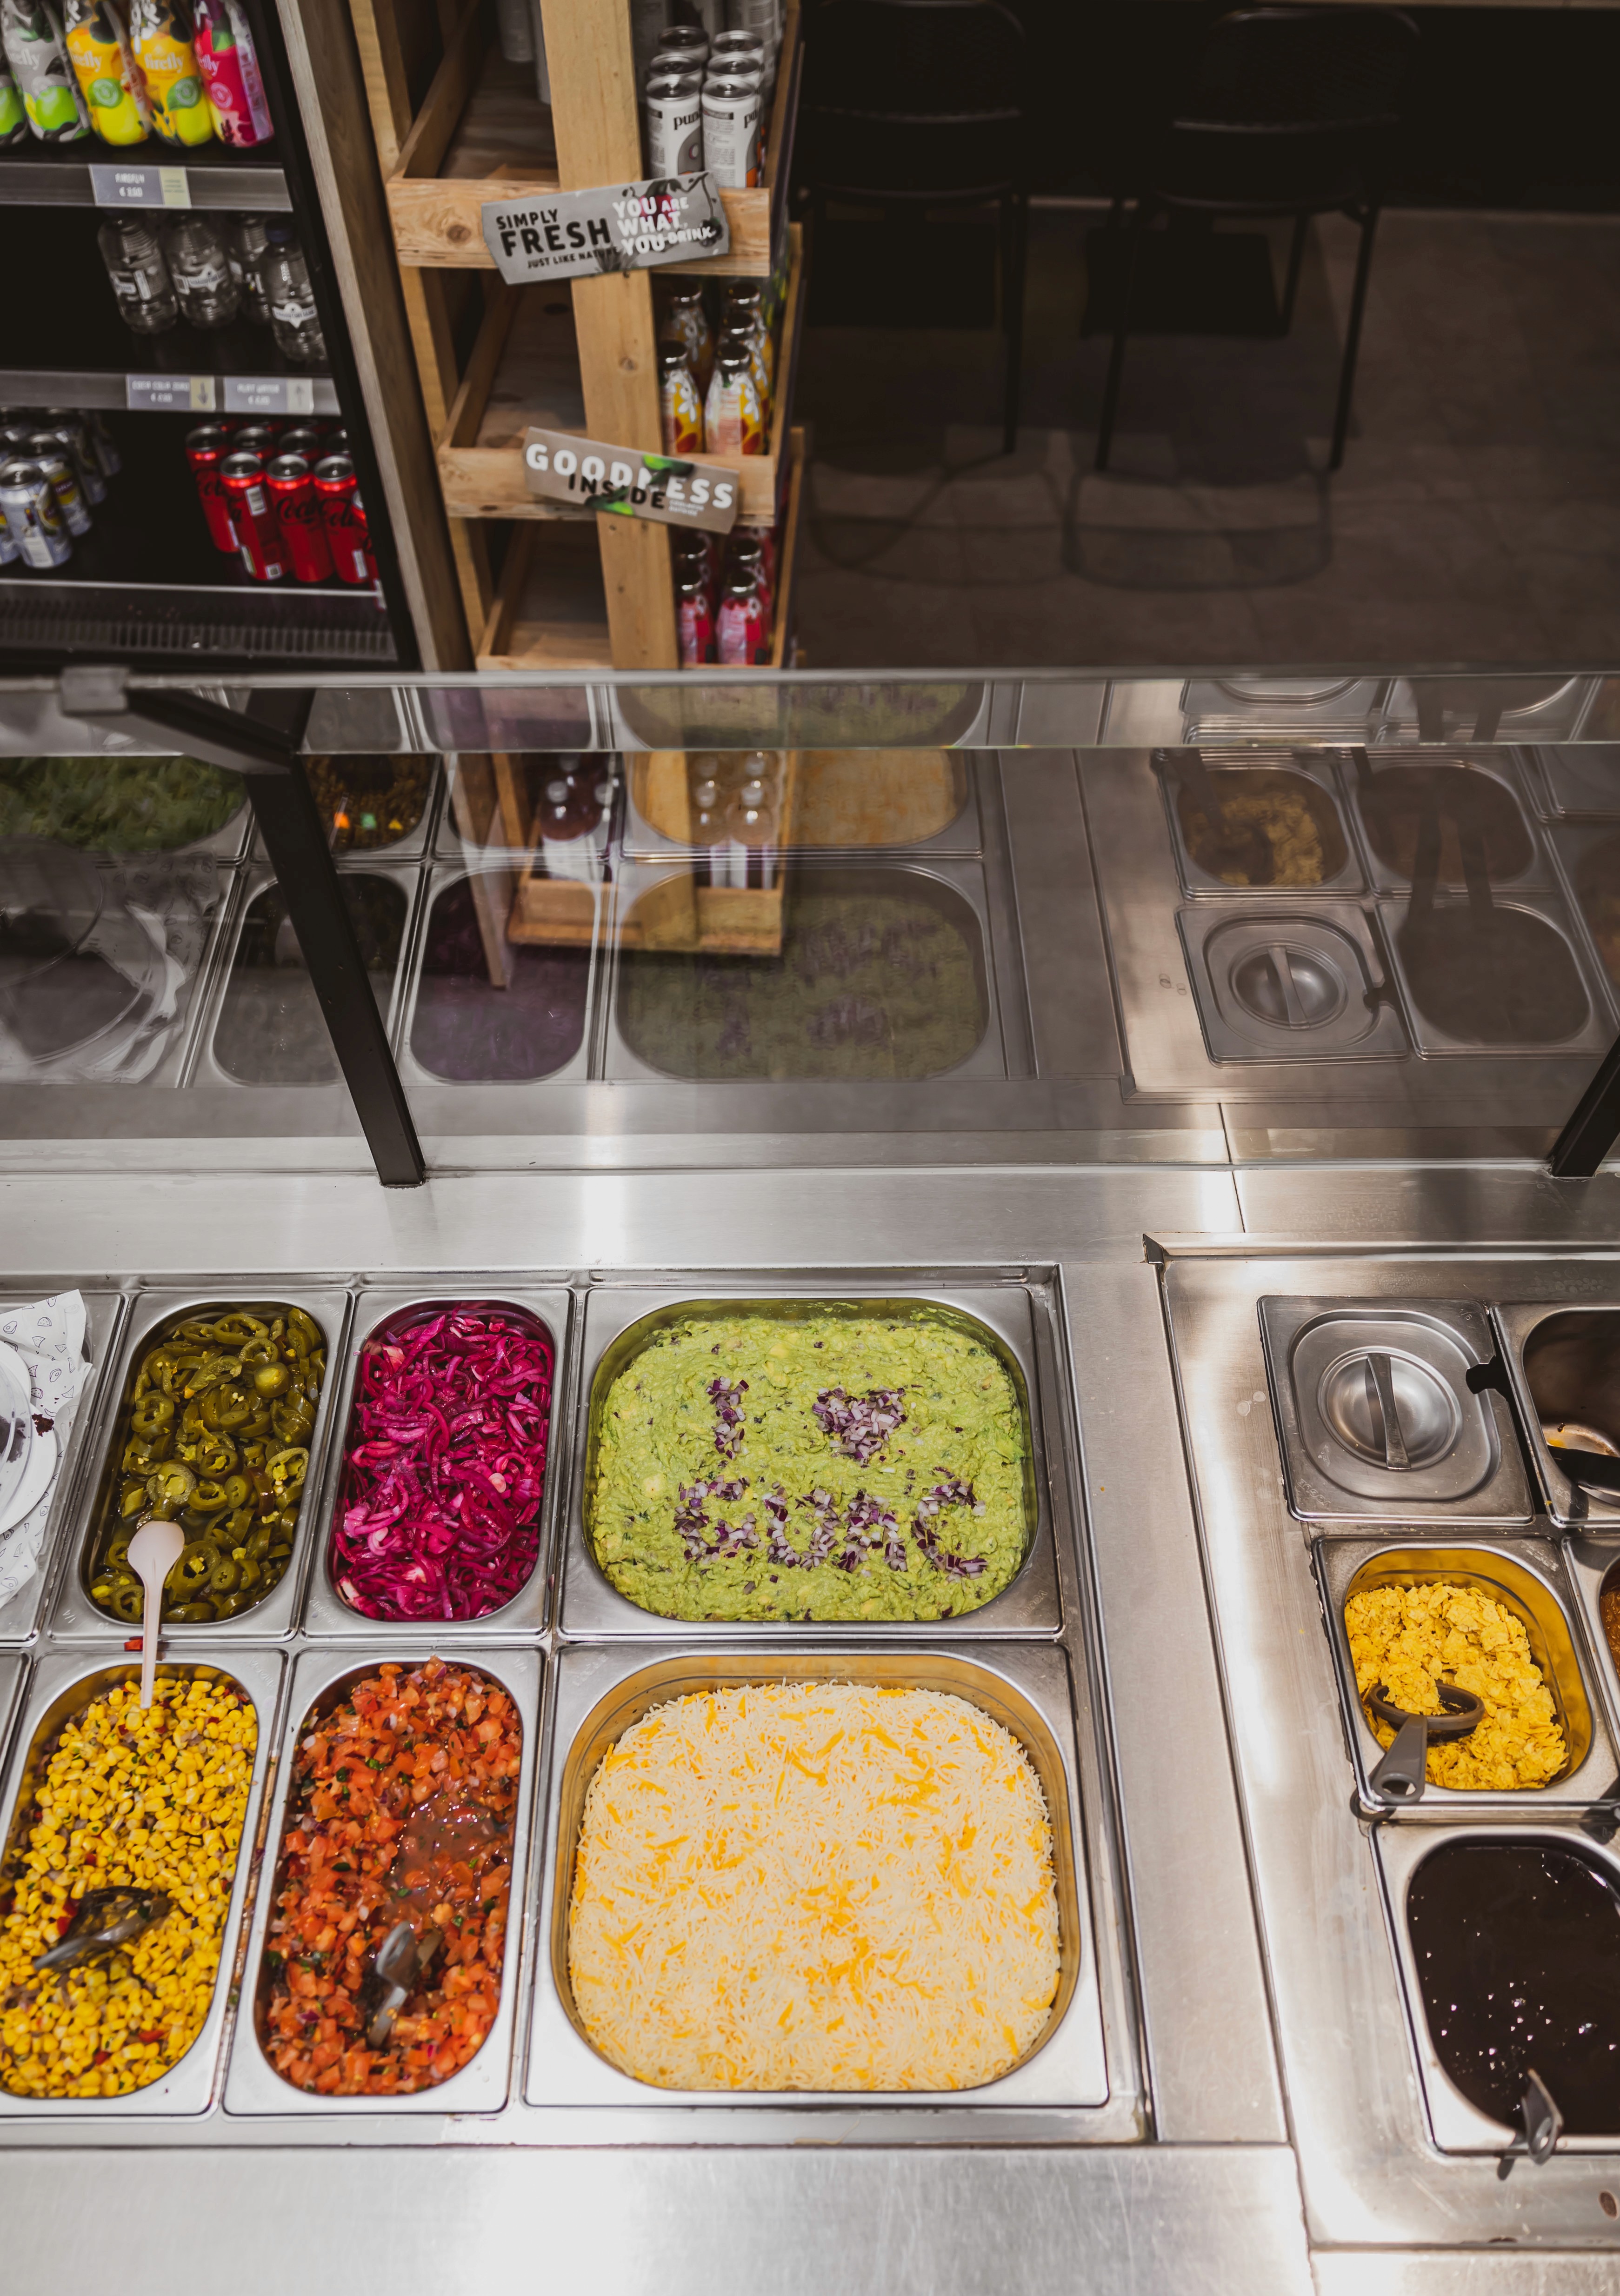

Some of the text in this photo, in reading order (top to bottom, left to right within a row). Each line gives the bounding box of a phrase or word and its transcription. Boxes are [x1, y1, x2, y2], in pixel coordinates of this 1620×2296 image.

[144, 51, 184, 74] firefly
[496, 208, 558, 230] SIMPLY
[612, 196, 689, 219] YOU ARE
[617, 212, 681, 237] WHAT
[499, 218, 611, 257] FRESH
[621, 226, 717, 256] YOU DRINK
[527, 256, 550, 269] JUST
[553, 253, 576, 265] LIKE
[526, 443, 733, 508] GOODNESS
